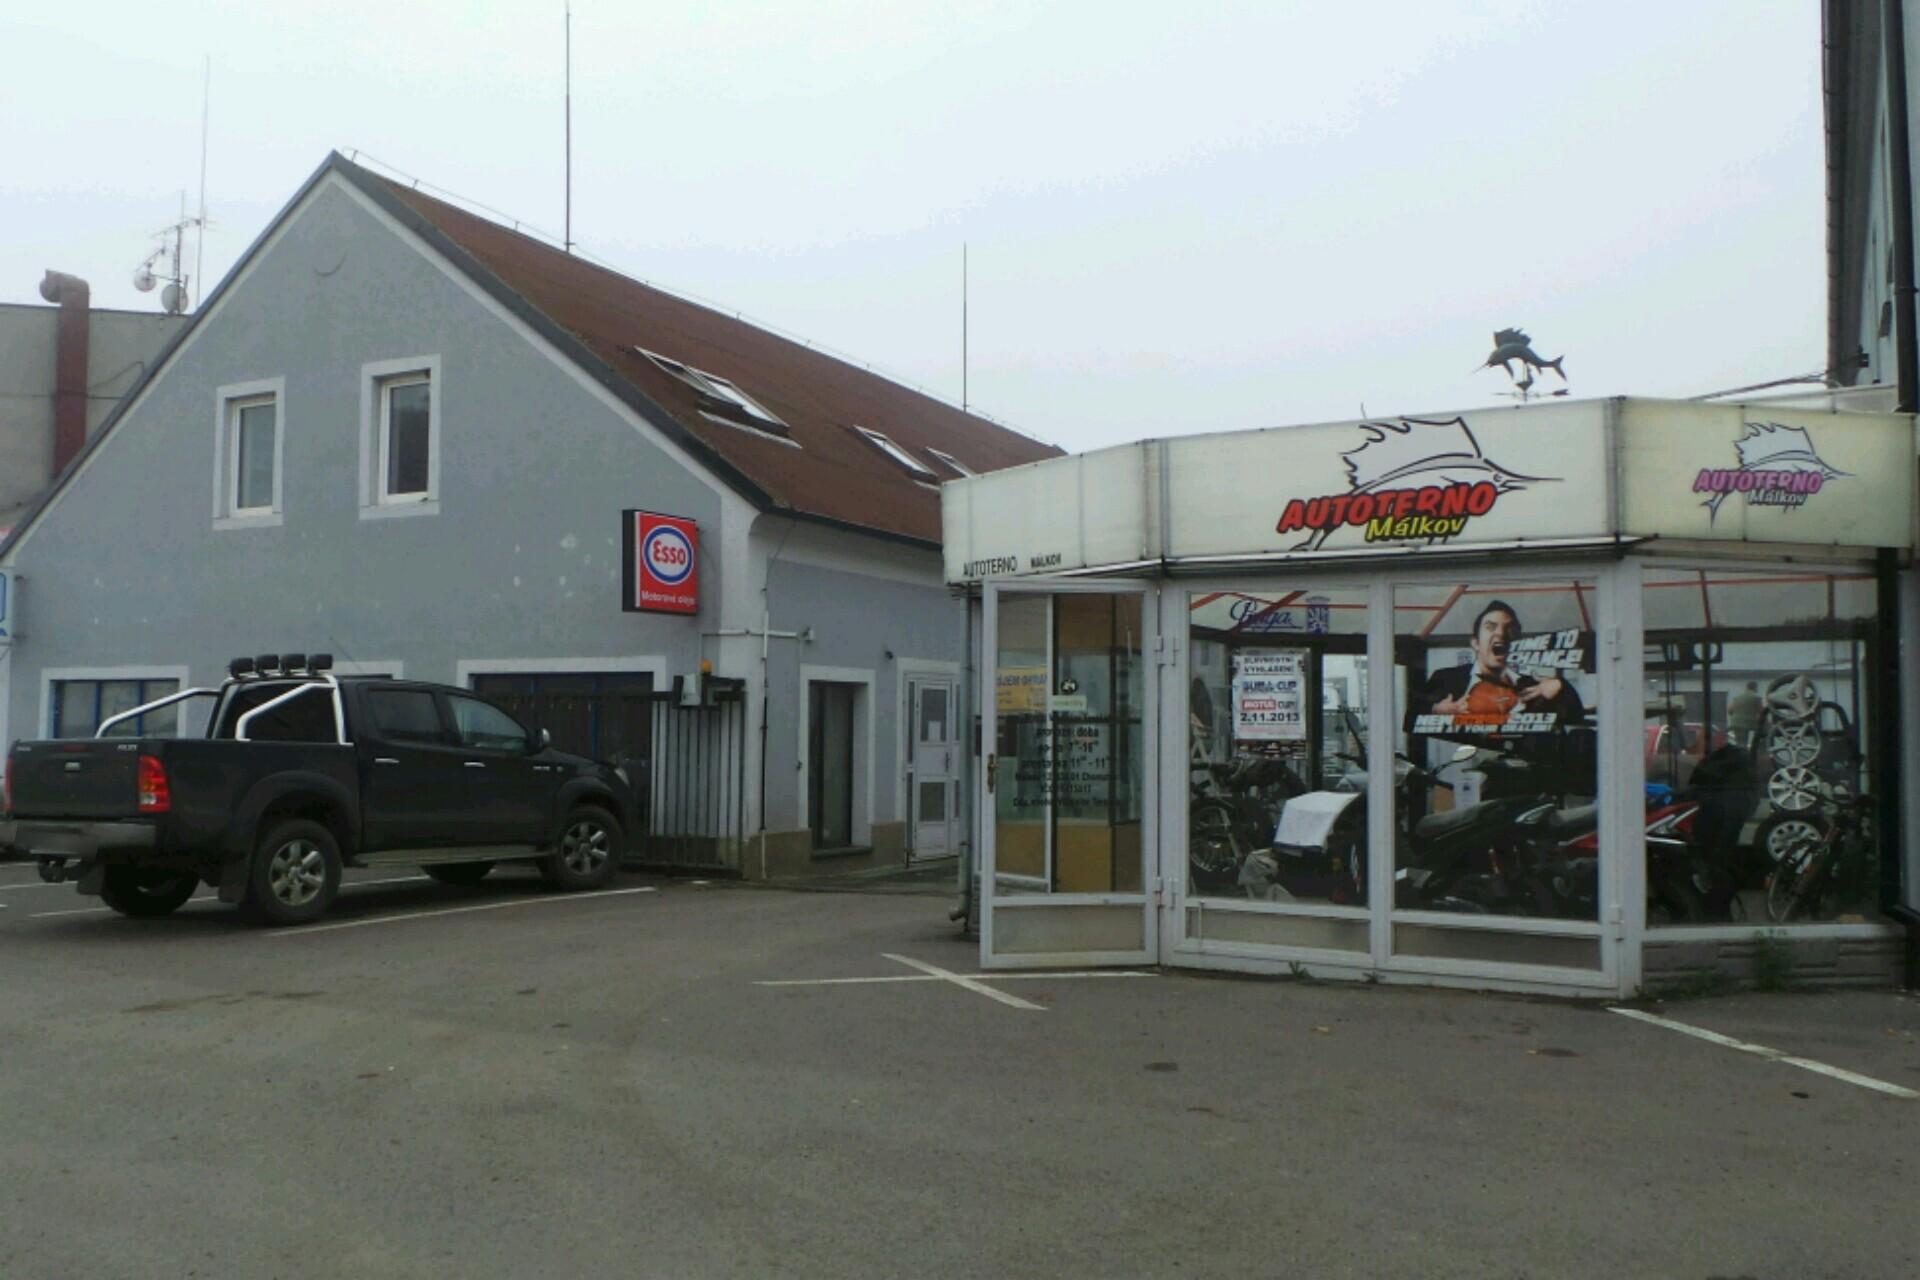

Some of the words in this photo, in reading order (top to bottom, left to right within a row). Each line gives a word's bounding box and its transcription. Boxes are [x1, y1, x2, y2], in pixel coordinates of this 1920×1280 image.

[1693, 468, 1824, 494] AUTOTERNO
[1276, 481, 1498, 533] AUTOTERNO
[1748, 488, 1808, 506] Málkov
[1364, 514, 1467, 542] Málkov
[963, 556, 1017, 577] AUTOTERNO
[1509, 634, 1551, 652] TIME
[1555, 629, 1579, 648] TO
[1507, 712, 1557, 725] 2013
